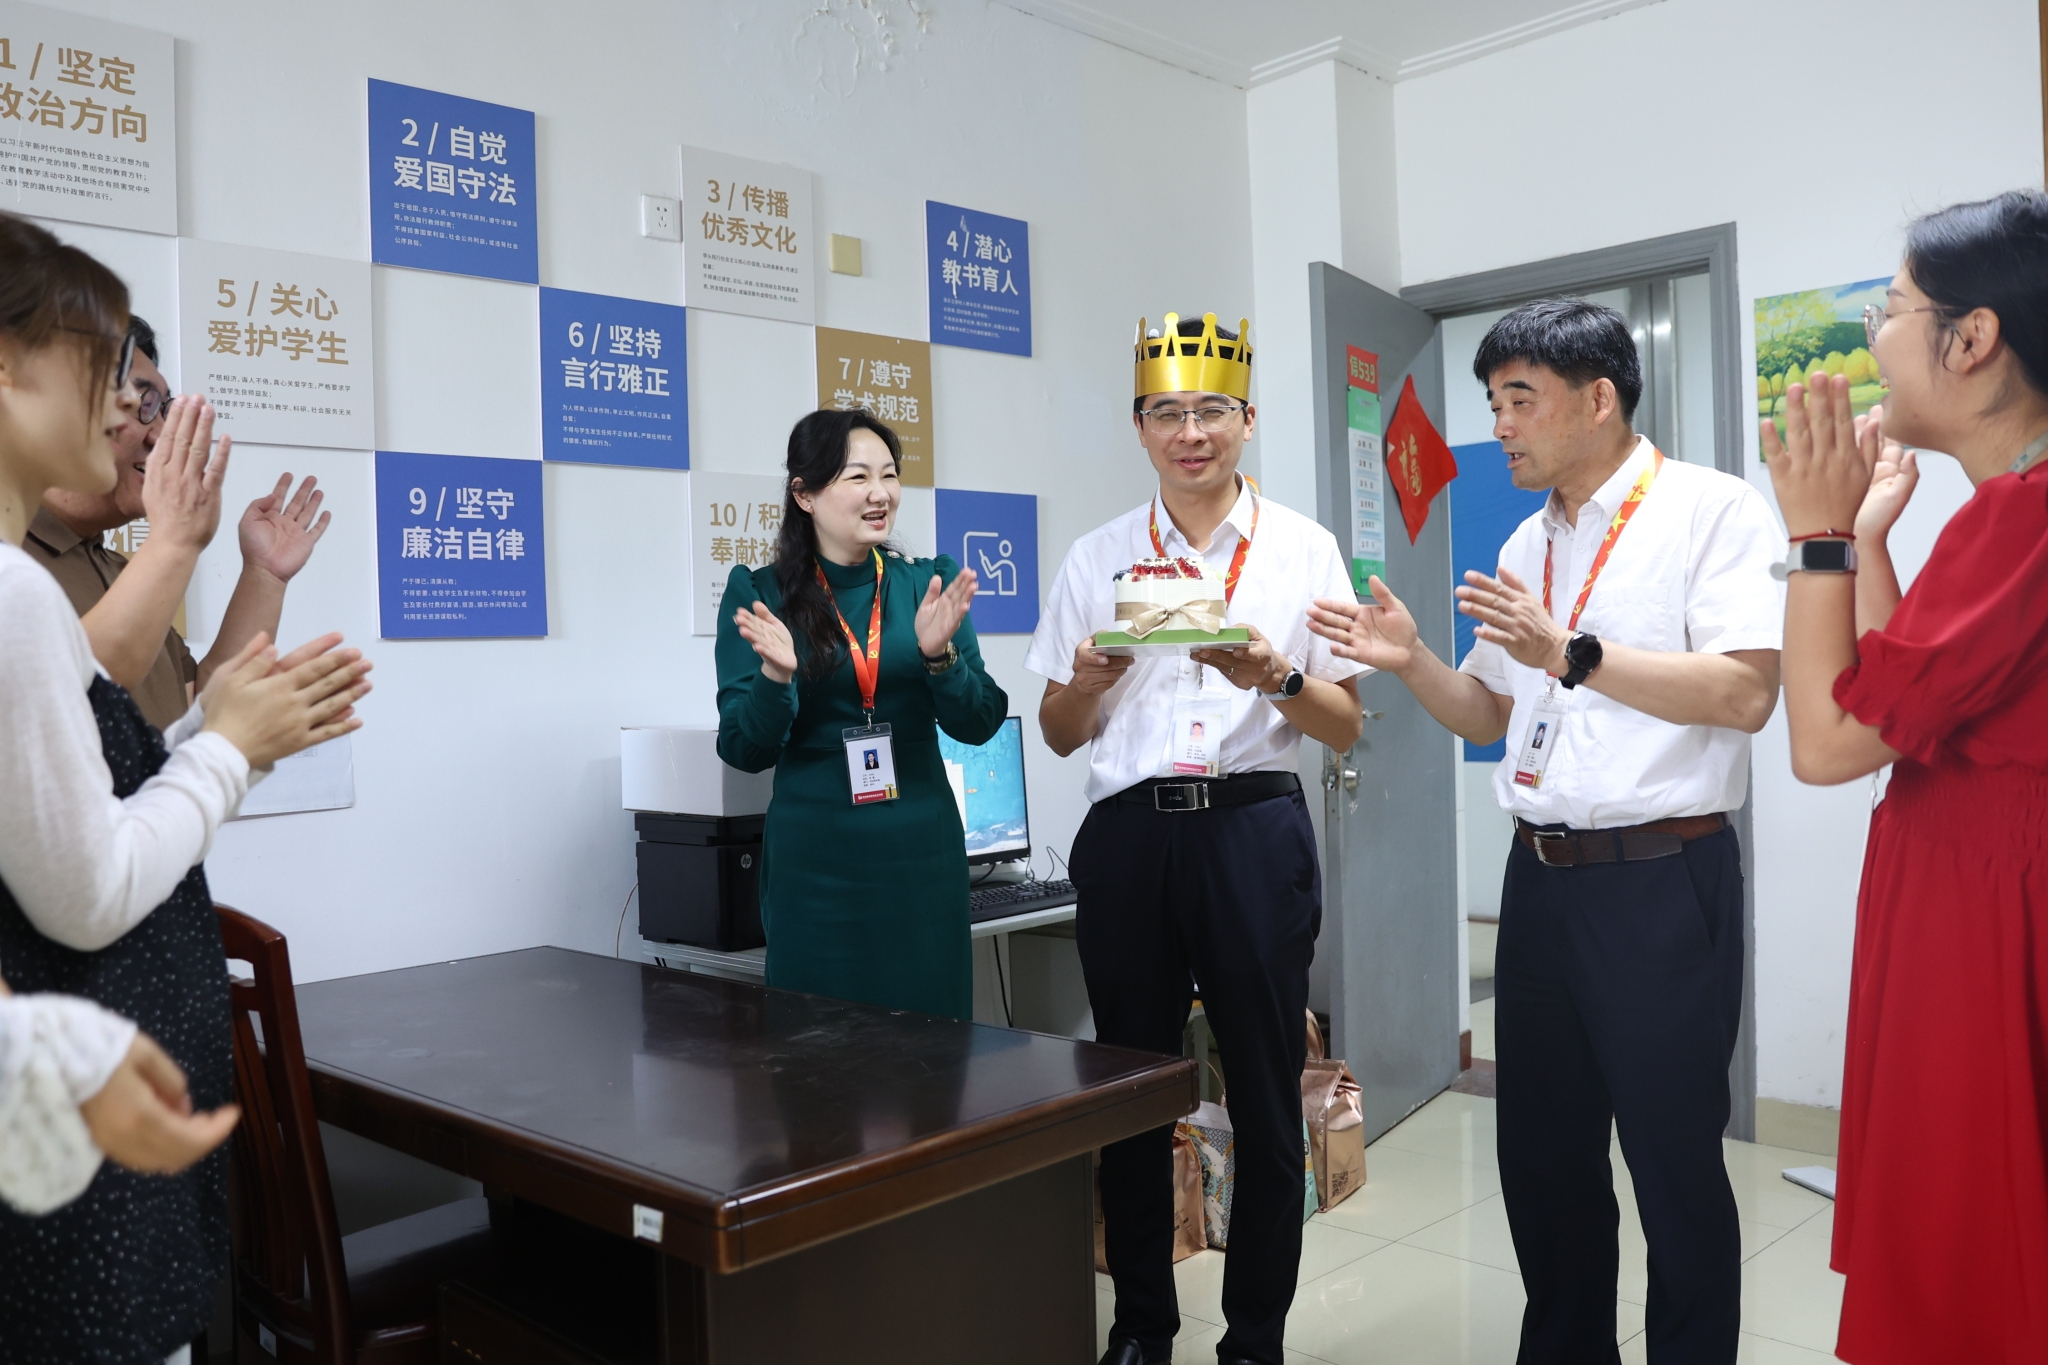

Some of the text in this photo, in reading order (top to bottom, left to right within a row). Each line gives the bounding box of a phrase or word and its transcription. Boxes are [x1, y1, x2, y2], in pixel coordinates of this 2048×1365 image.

[393, 156, 517, 206] 爱国守法
[701, 211, 797, 254] 优秀文化
[942, 258, 1019, 296] 教书育人
[208, 320, 349, 365] 爱护学生
[561, 357, 670, 397] 言行雅正
[213, 412, 234, 420] 事宜。
[834, 388, 919, 423] 学术规范
[401, 526, 525, 561] 廉洁自律
